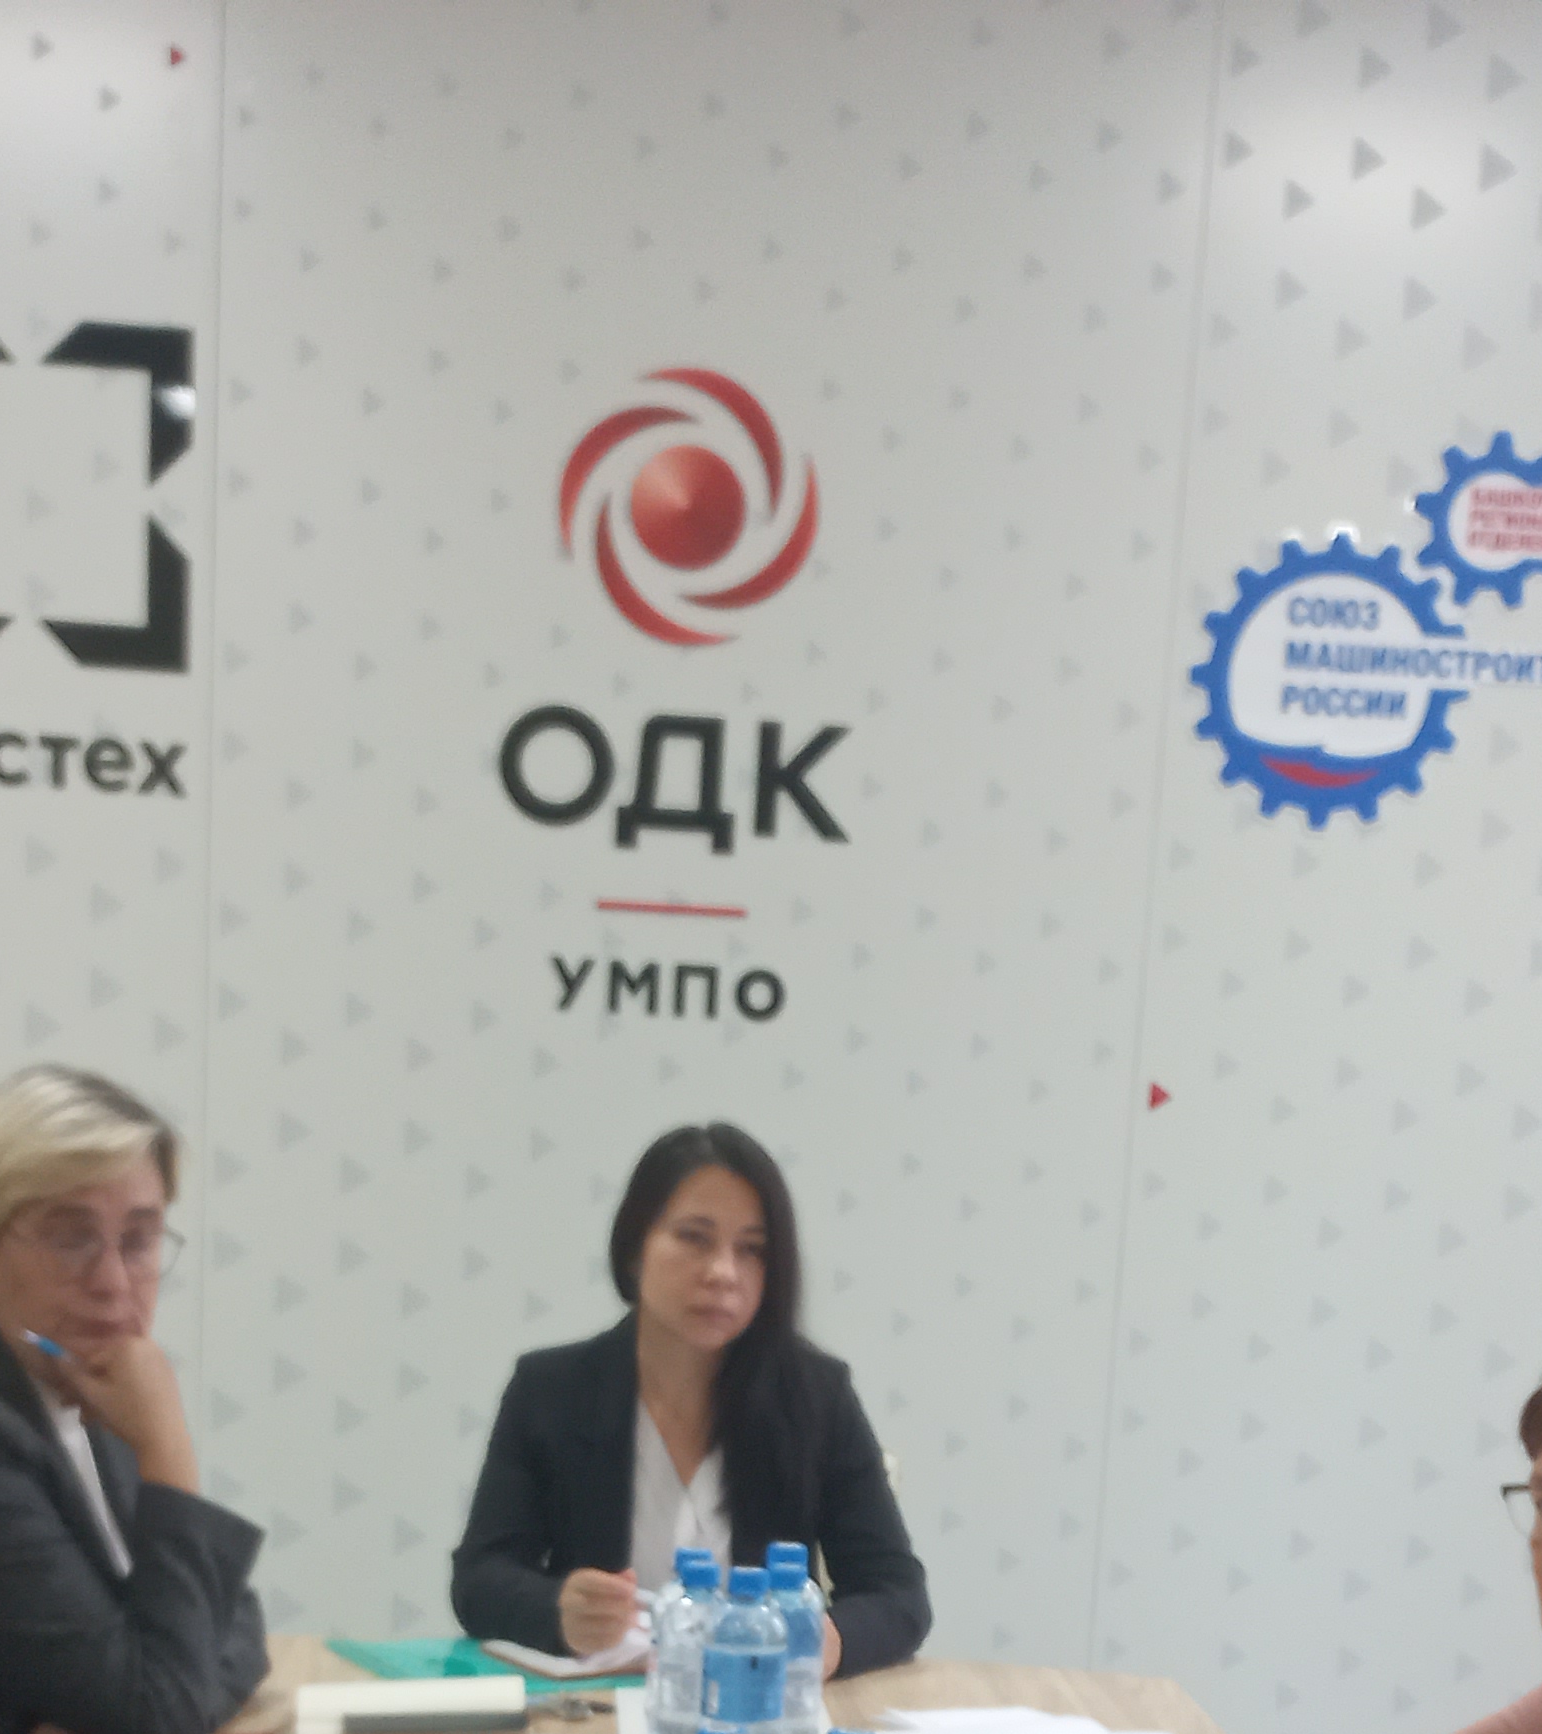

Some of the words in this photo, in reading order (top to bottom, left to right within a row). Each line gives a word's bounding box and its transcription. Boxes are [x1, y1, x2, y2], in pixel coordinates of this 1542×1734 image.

[1286, 597, 1379, 630] СОЮЗ
[1281, 686, 1407, 717] РОССИИ
[498, 704, 853, 856] ОДК
[550, 956, 786, 1023] УМПО
